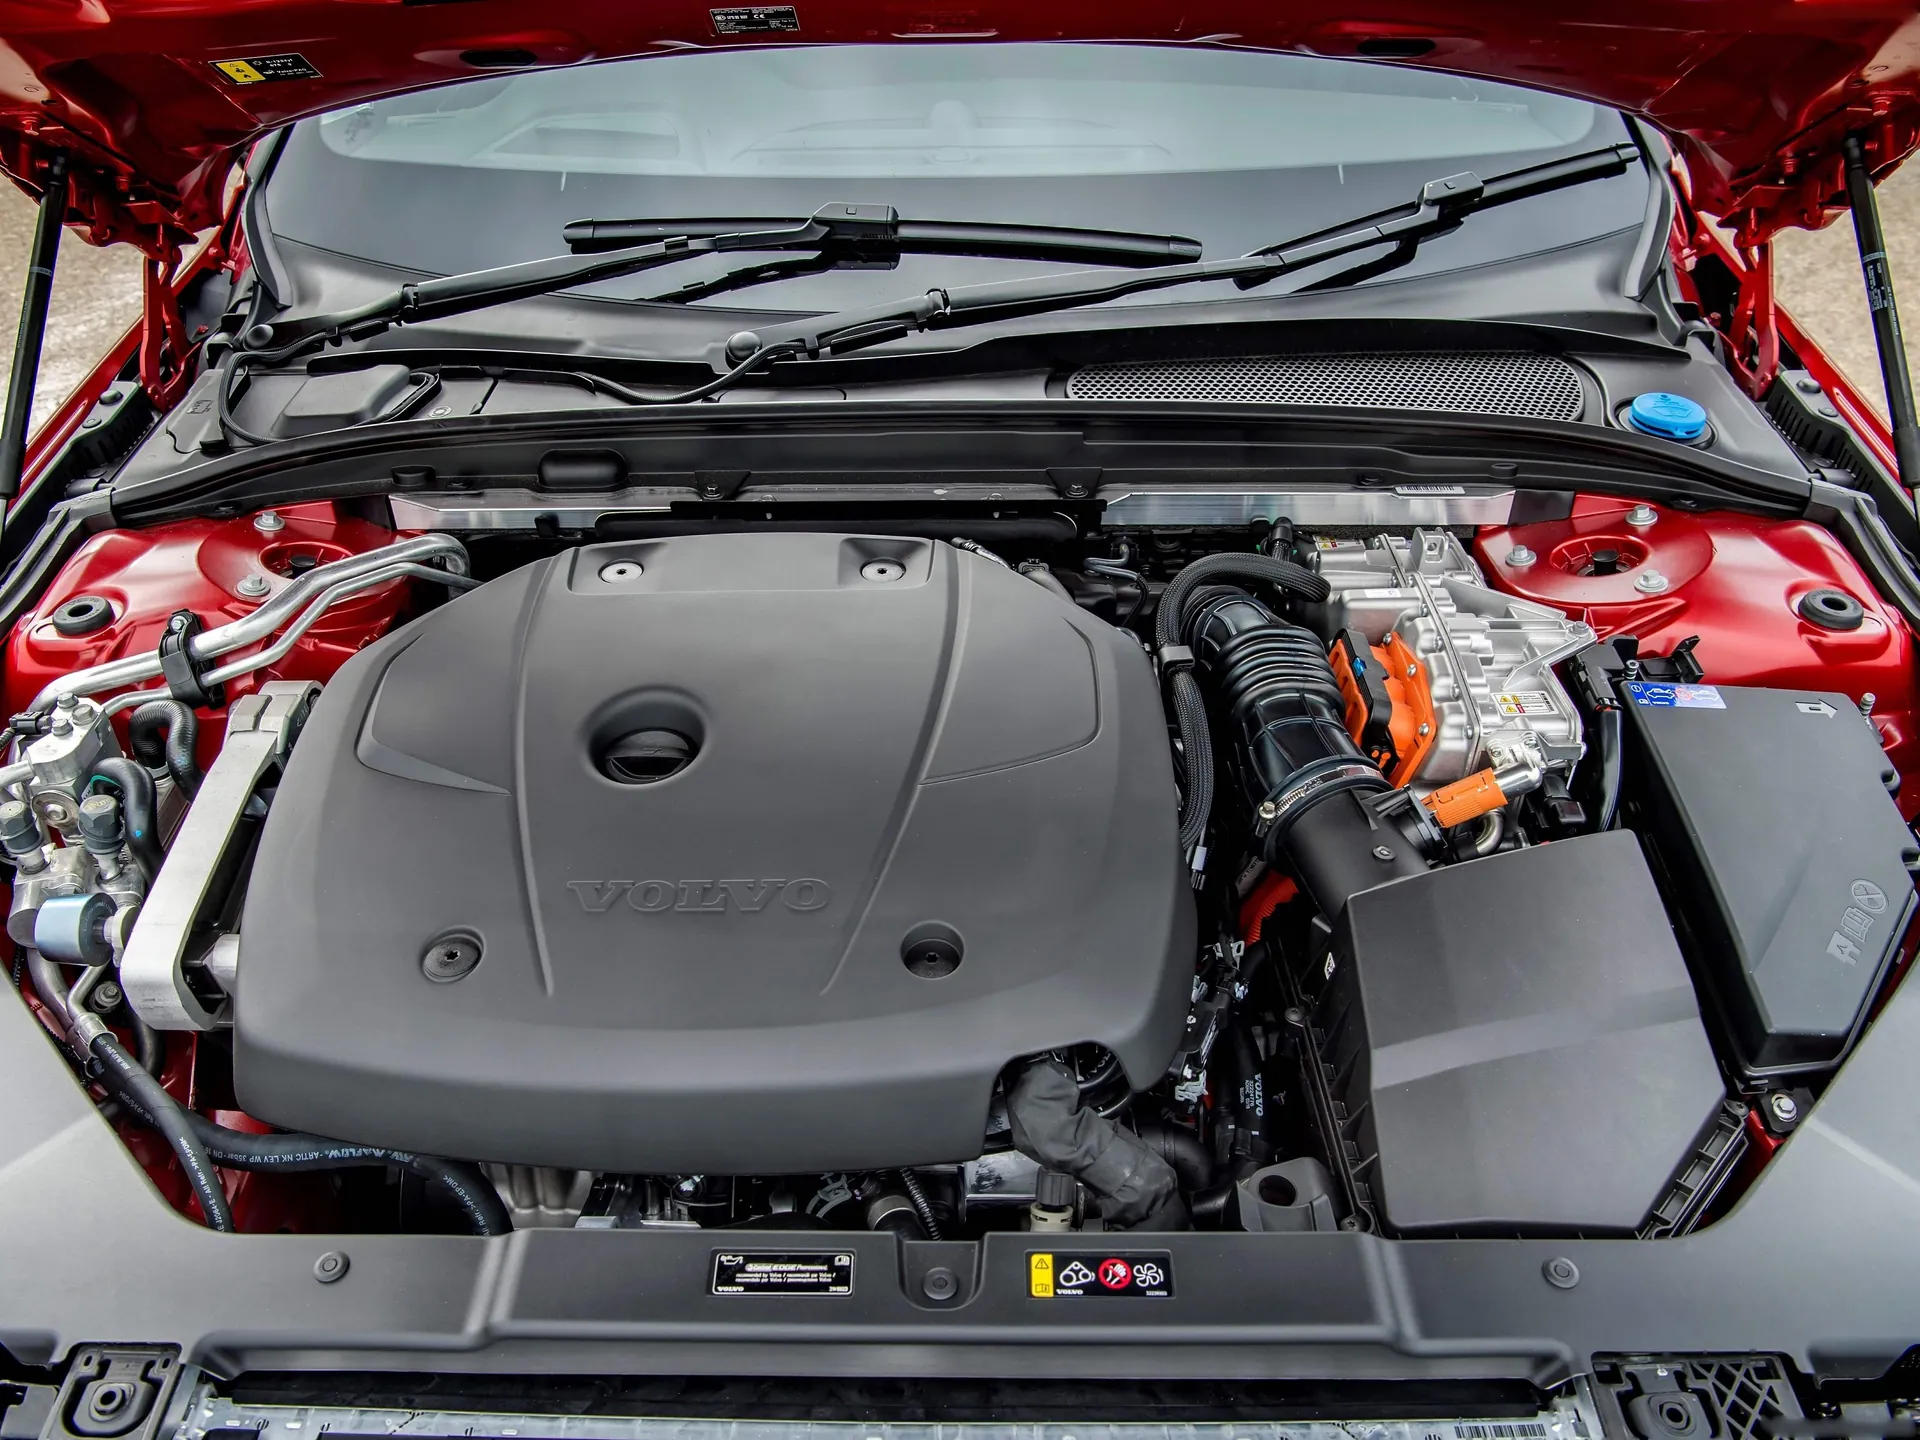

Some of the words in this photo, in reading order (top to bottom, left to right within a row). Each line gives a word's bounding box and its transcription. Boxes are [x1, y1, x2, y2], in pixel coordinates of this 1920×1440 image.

[566, 877, 832, 912] VOLVO
[1255, 1073, 1263, 1116] VOLVO
[249, 1154, 262, 1163] WP
[263, 1154, 280, 1163] LEV
[281, 1154, 293, 1162] NK
[202, 1184, 213, 1194] All
